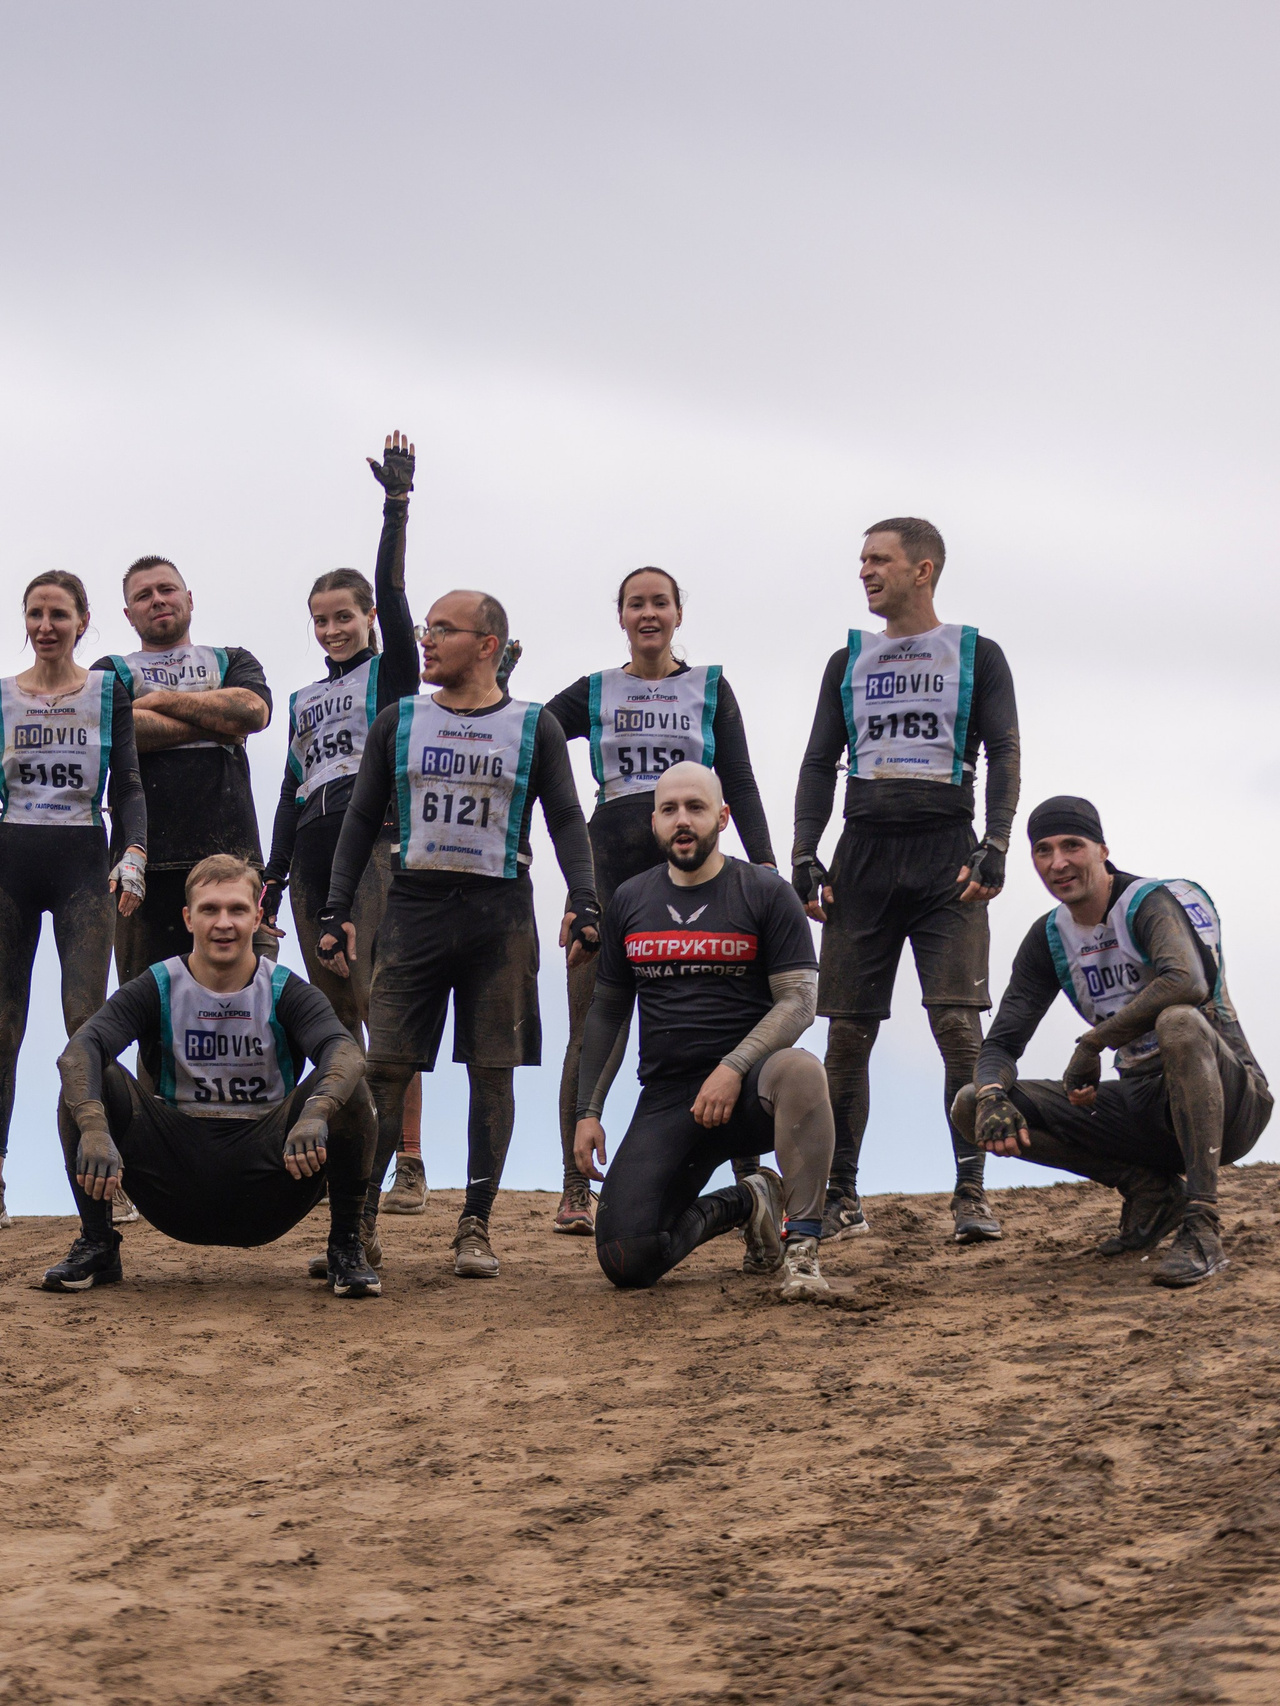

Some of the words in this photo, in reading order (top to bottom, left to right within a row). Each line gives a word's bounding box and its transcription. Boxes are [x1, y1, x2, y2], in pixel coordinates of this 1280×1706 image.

[878, 653, 903, 662] ГОНКА
[904, 652, 932, 660] ГЕРОЕВ
[141, 665, 207, 686] RODVIG
[866, 672, 944, 699] RODVIG
[615, 710, 690, 733] RODVIG
[867, 711, 939, 741] 5163
[15, 725, 87, 748] RODVIG
[438, 729, 463, 738] ГОНКА
[464, 731, 493, 740] ГЕРОЕВ
[422, 747, 503, 778] RODVIG
[18, 763, 84, 790] 5165
[422, 791, 490, 828] 6121
[439, 844, 483, 856] ГАЗПРОМБАНК
[626, 939, 749, 957] ИНСТРУКТОР
[198, 1010, 223, 1018] ГОНКА
[224, 1010, 251, 1018] ГЕРОЕВ
[186, 1031, 264, 1059] RODVIG
[192, 1076, 269, 1102] 5162
